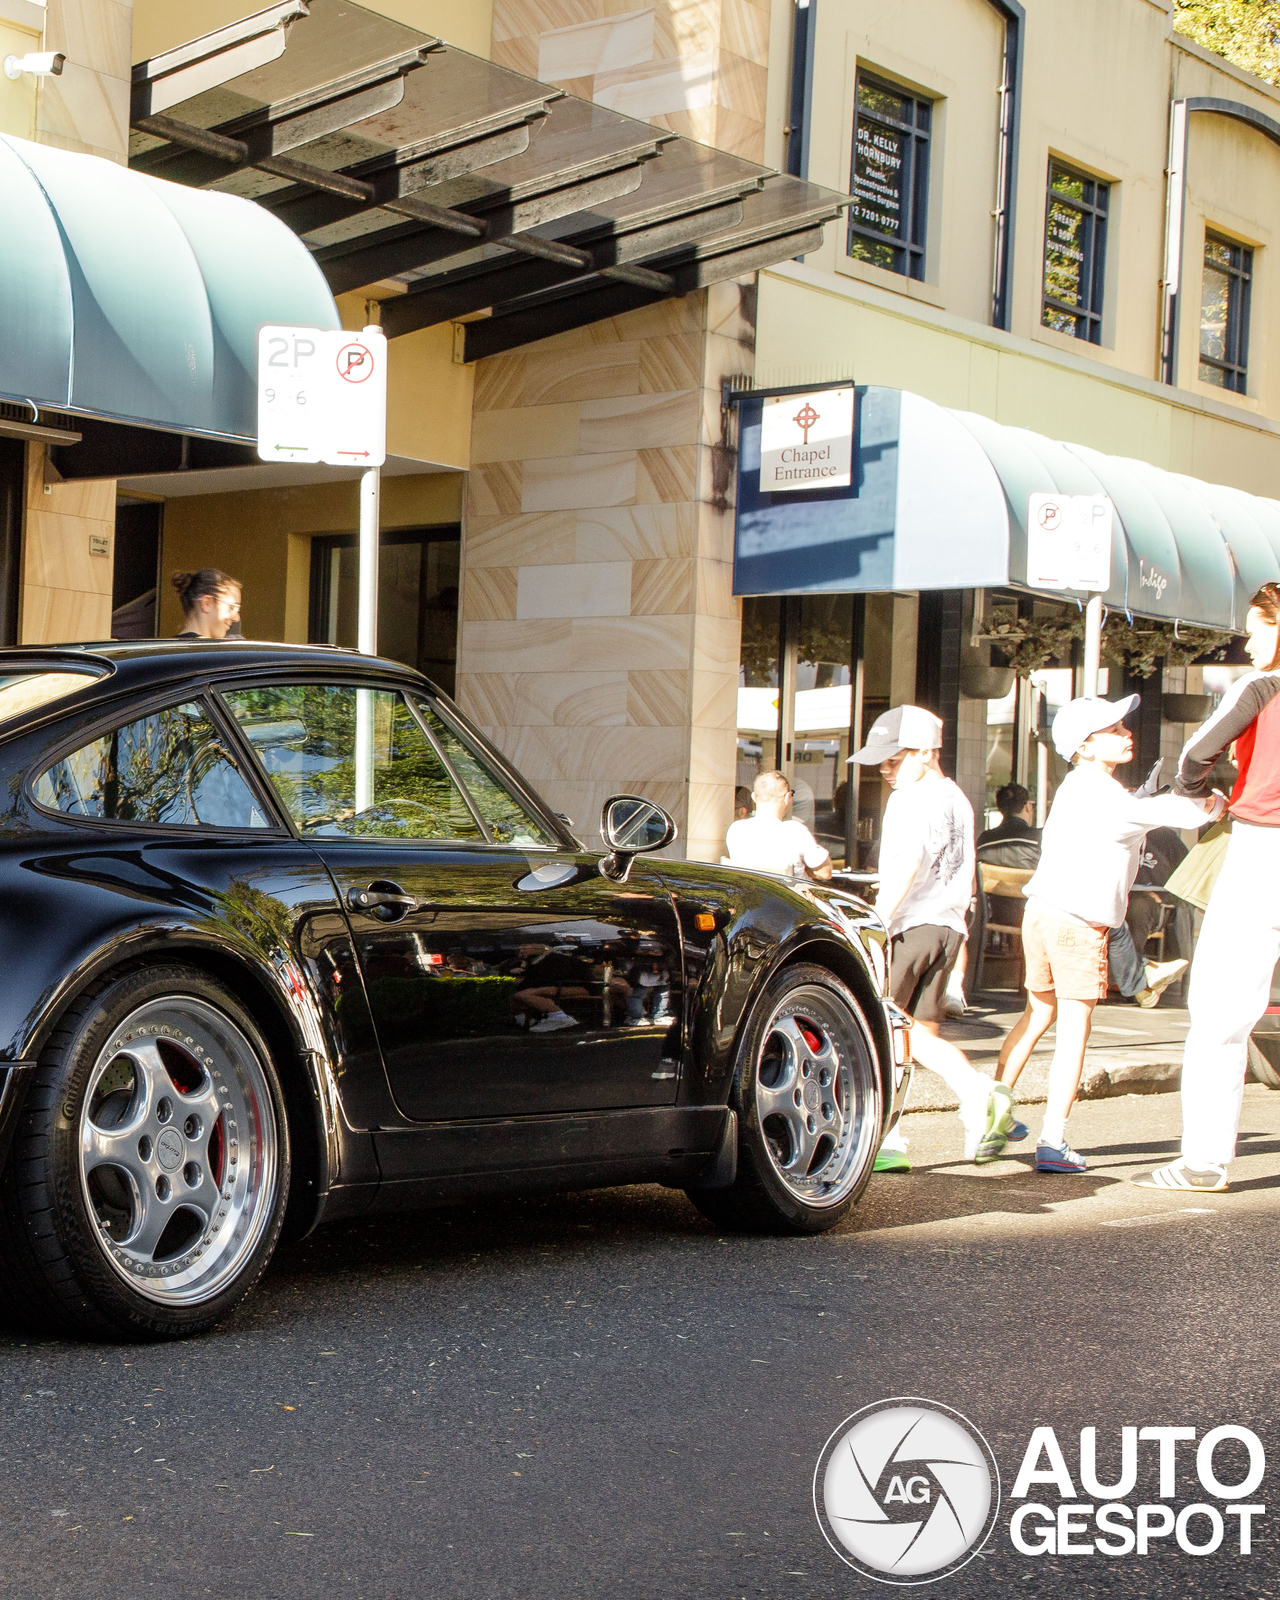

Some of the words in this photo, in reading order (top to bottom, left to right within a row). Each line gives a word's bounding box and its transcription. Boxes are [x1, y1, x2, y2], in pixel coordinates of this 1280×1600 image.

[857, 128, 872, 143] DR.
[873, 135, 898, 153] KELLY
[876, 194, 899, 210] Surgeon
[861, 207, 879, 222] 7201
[881, 214, 899, 229] 0777
[267, 337, 316, 368] 2P
[781, 445, 831, 465] Chapel
[774, 466, 837, 481] Entrance
[92, 538, 109, 546] TOILET
[1139, 559, 1168, 600] Indigo
